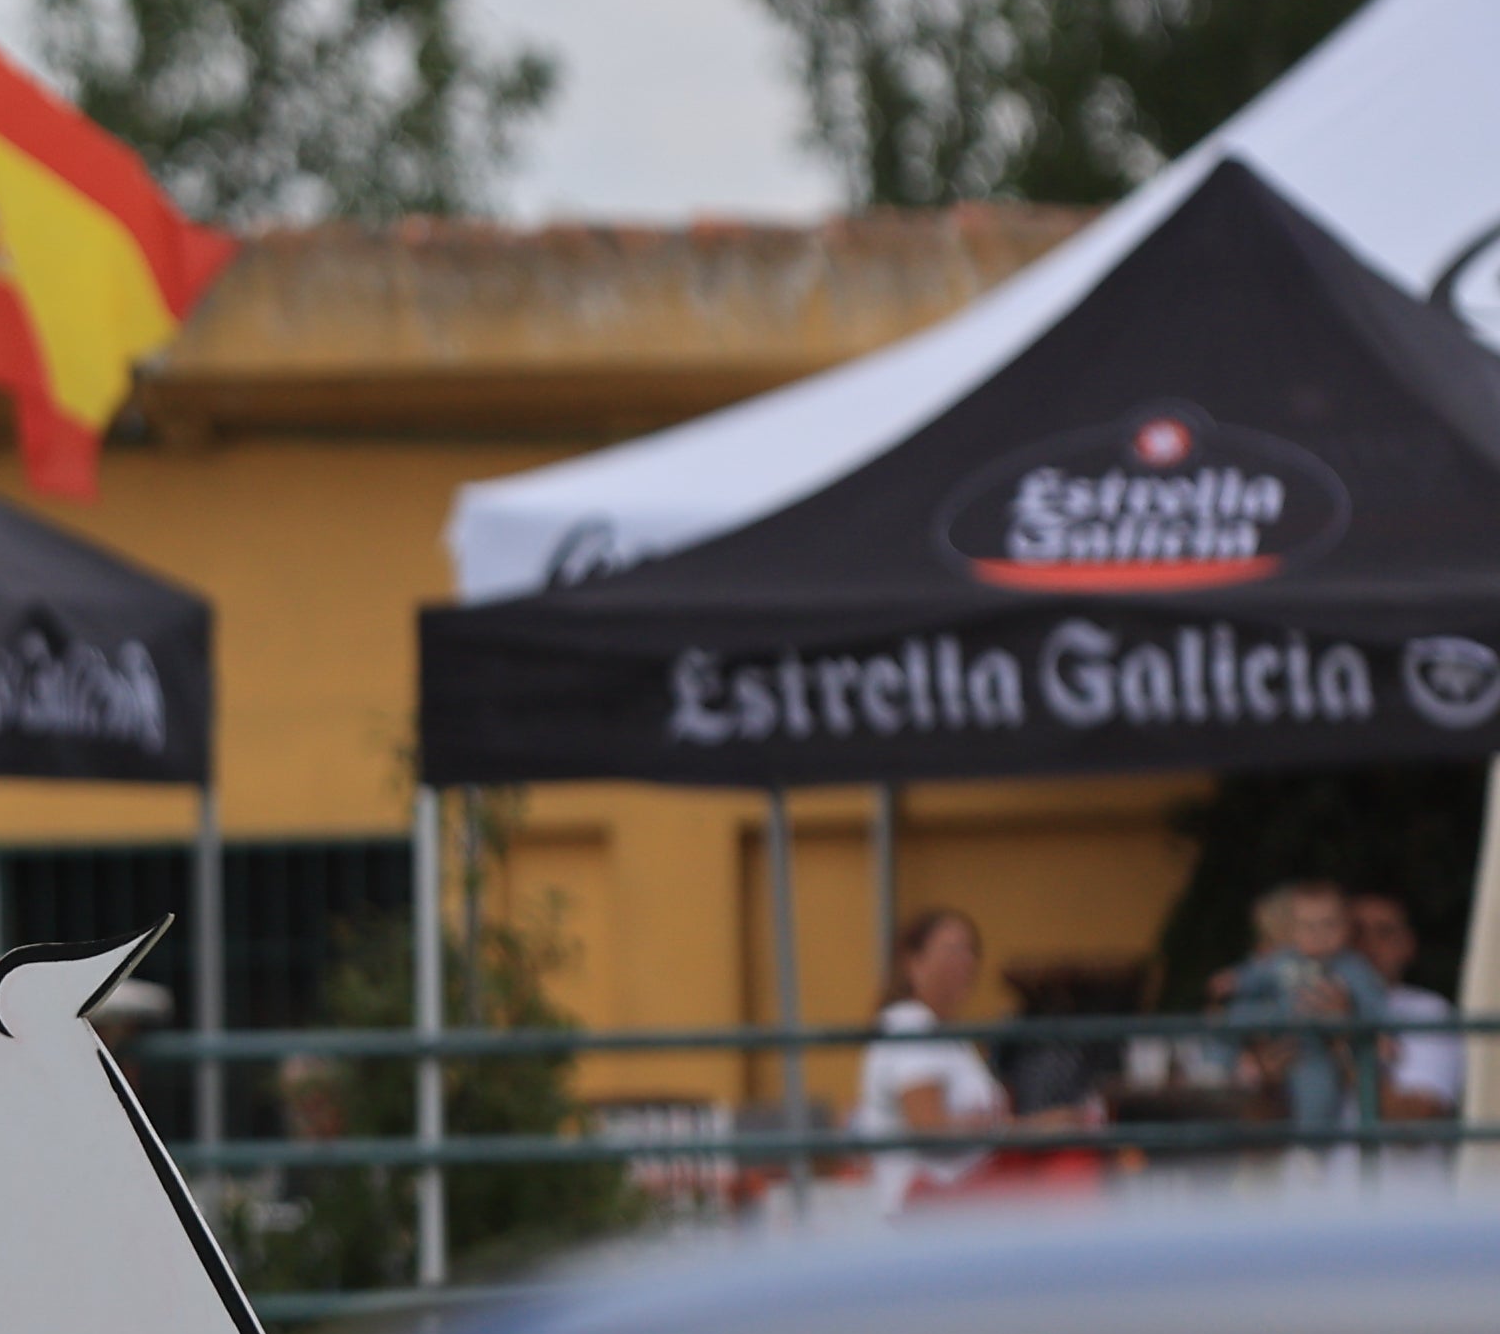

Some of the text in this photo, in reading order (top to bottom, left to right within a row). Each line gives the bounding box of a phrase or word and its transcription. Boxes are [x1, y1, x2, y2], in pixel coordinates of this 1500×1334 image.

[1006, 467, 1283, 524] Estrella
[668, 617, 1373, 743] Estrella Galicia
